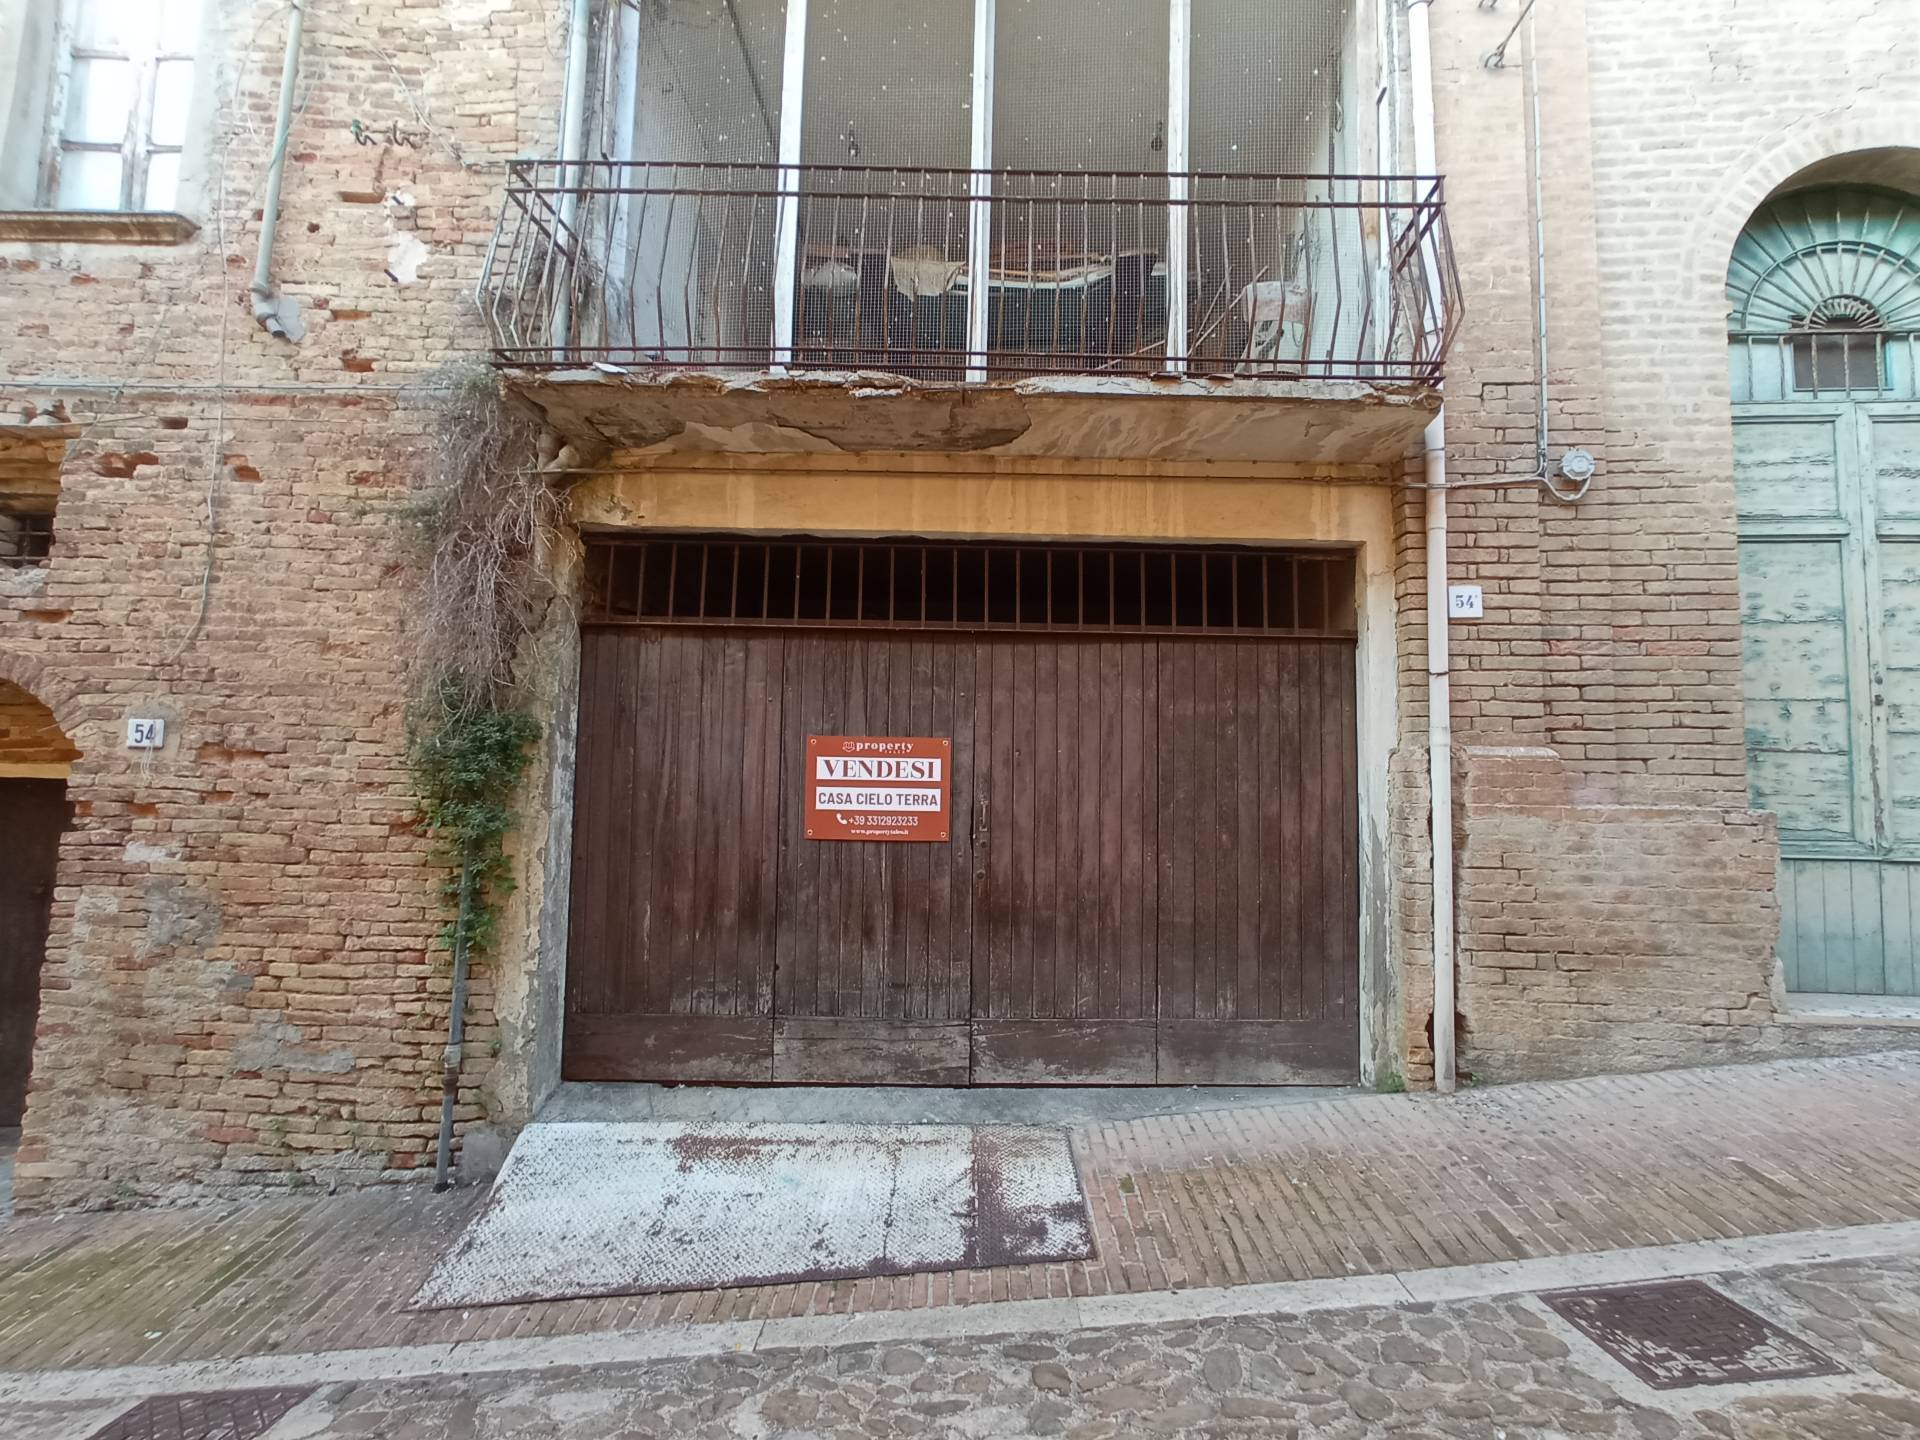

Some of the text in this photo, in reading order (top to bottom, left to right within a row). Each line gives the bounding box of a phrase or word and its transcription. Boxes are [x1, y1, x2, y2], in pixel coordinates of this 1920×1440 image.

[856, 742, 914, 753] property
[824, 759, 934, 779] VENDESI
[818, 792, 938, 806] CASA CIELO TERRA
[848, 815, 918, 827] +39 3312923233
